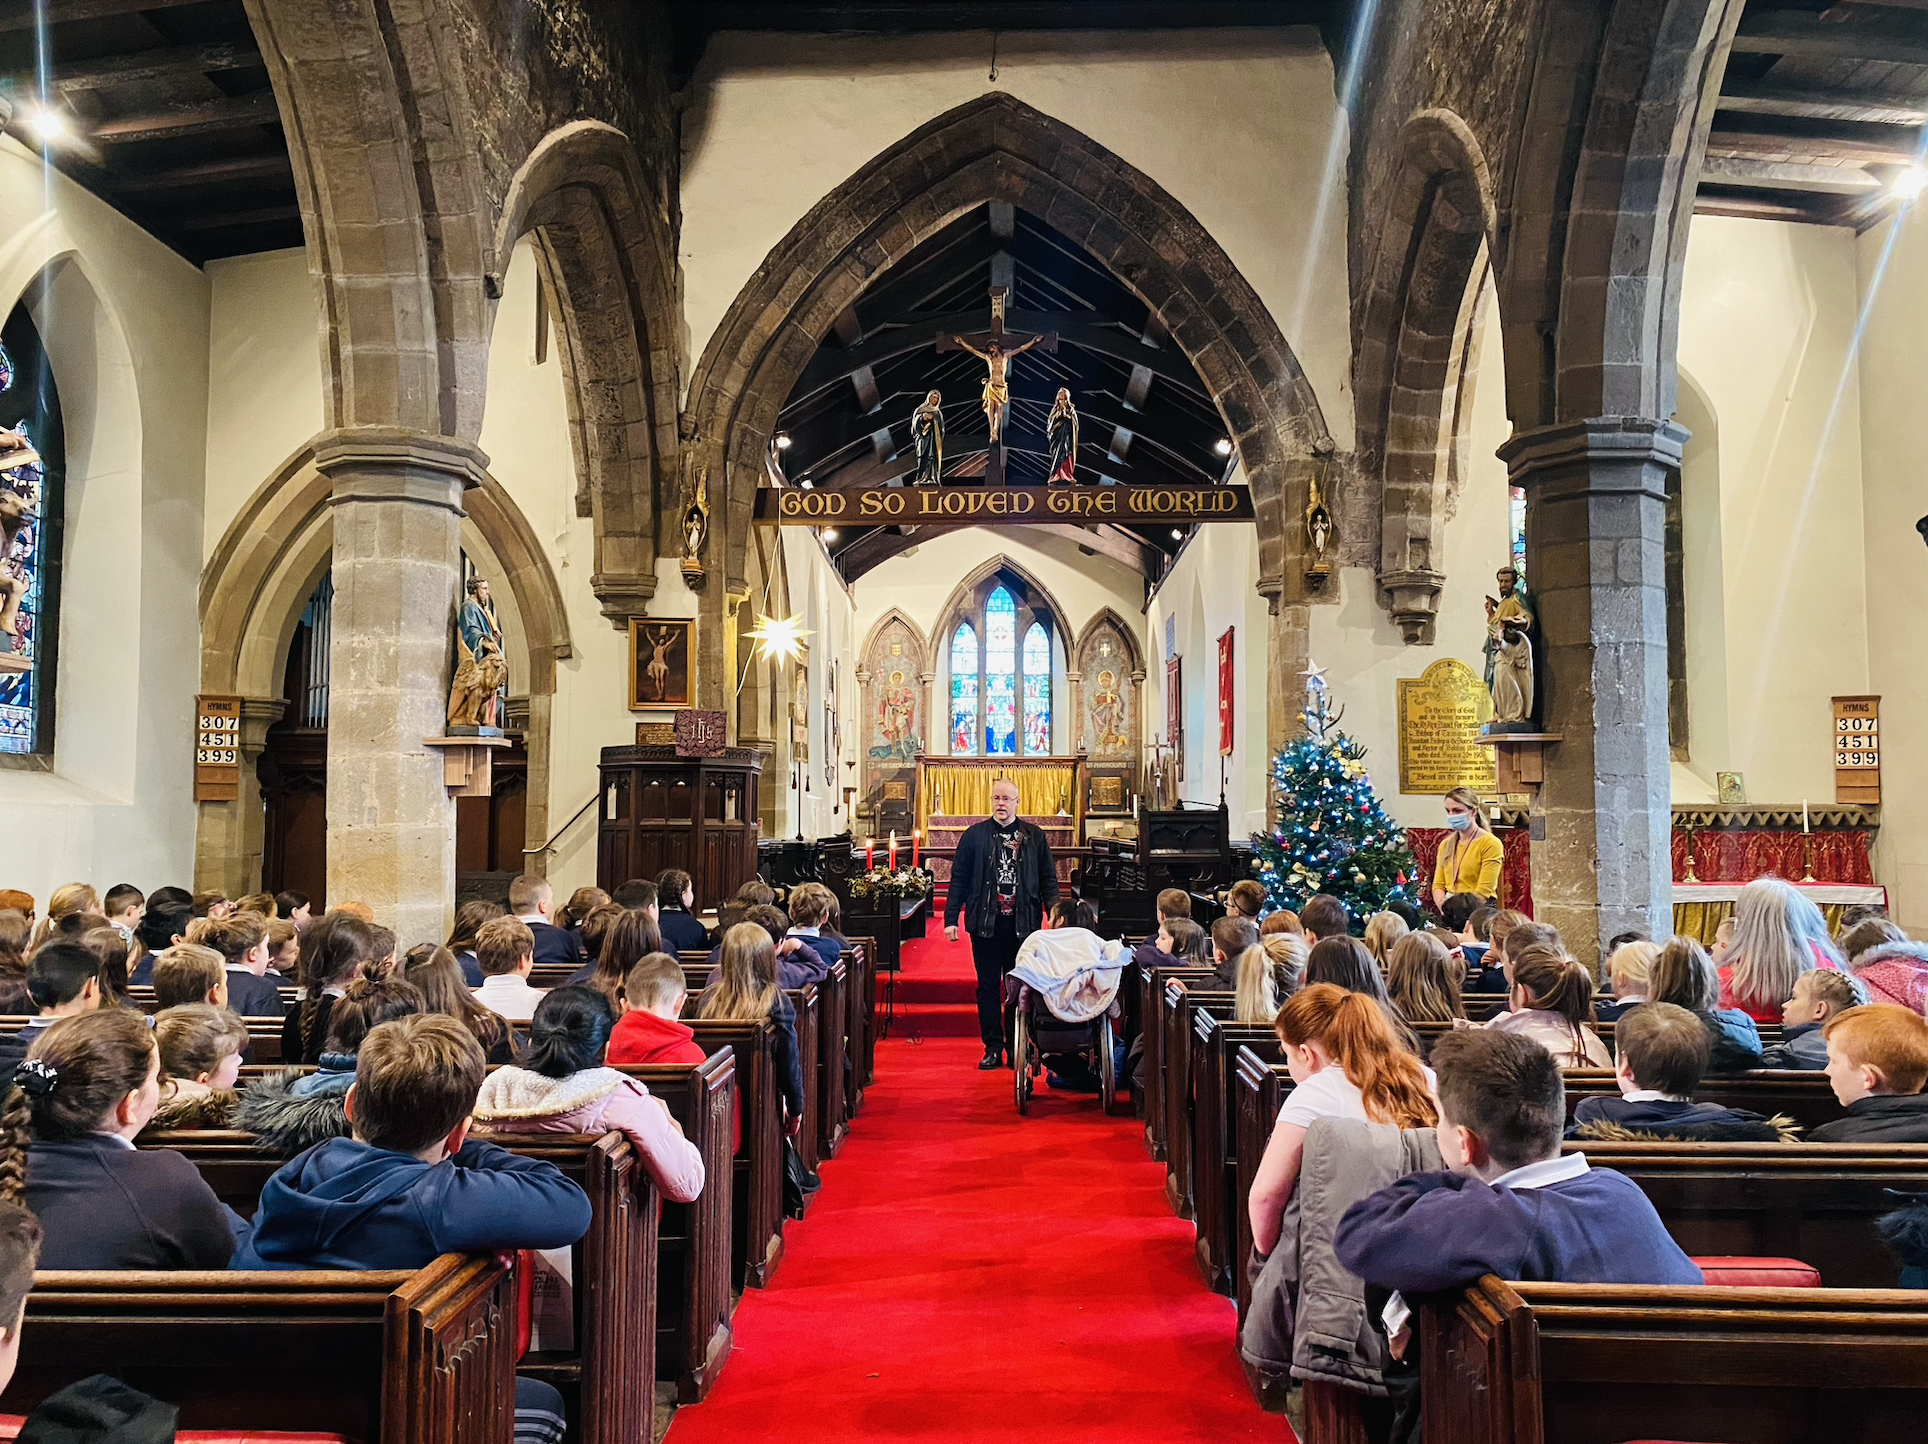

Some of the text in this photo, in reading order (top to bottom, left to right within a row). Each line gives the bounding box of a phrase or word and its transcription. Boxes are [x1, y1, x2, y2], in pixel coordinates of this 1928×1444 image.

[780, 490, 847, 516] GOD
[860, 489, 906, 516] SO
[918, 489, 1036, 515] LOVED
[1129, 488, 1239, 515] WORLD
[207, 703, 232, 711] HYMNS
[1842, 704, 1869, 712] HYMNS
[202, 717, 237, 729] 307
[1839, 718, 1875, 730] 307
[202, 733, 235, 745] 451
[1838, 735, 1873, 748] 451
[199, 750, 234, 762] 399
[1838, 752, 1875, 764] 399
